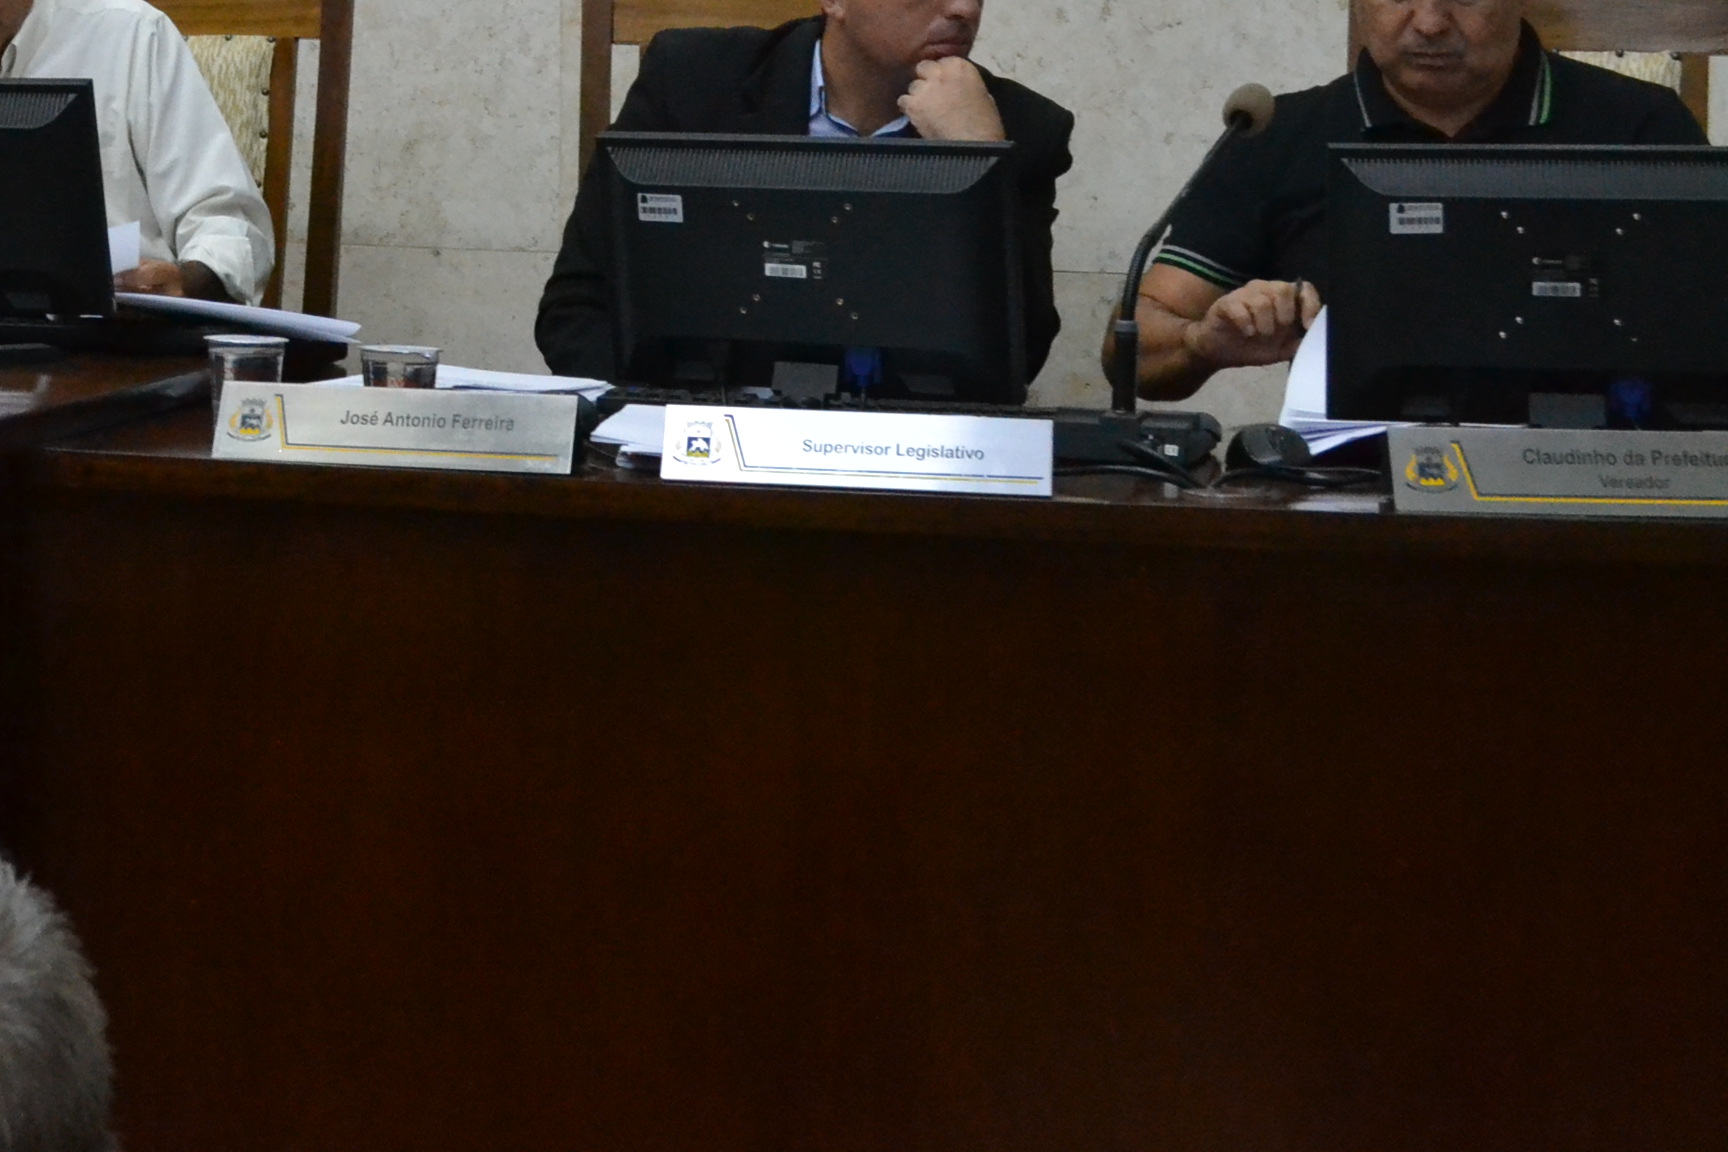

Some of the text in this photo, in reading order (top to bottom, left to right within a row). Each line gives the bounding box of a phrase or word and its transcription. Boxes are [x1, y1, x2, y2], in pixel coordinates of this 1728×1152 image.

[340, 409, 515, 432] José Antonio Ferreira
[801, 438, 985, 461] Supervisor Legislativo
[1522, 448, 1617, 466] Claudinho
[1623, 449, 1645, 466] da
[1599, 474, 1670, 489] Vereador
